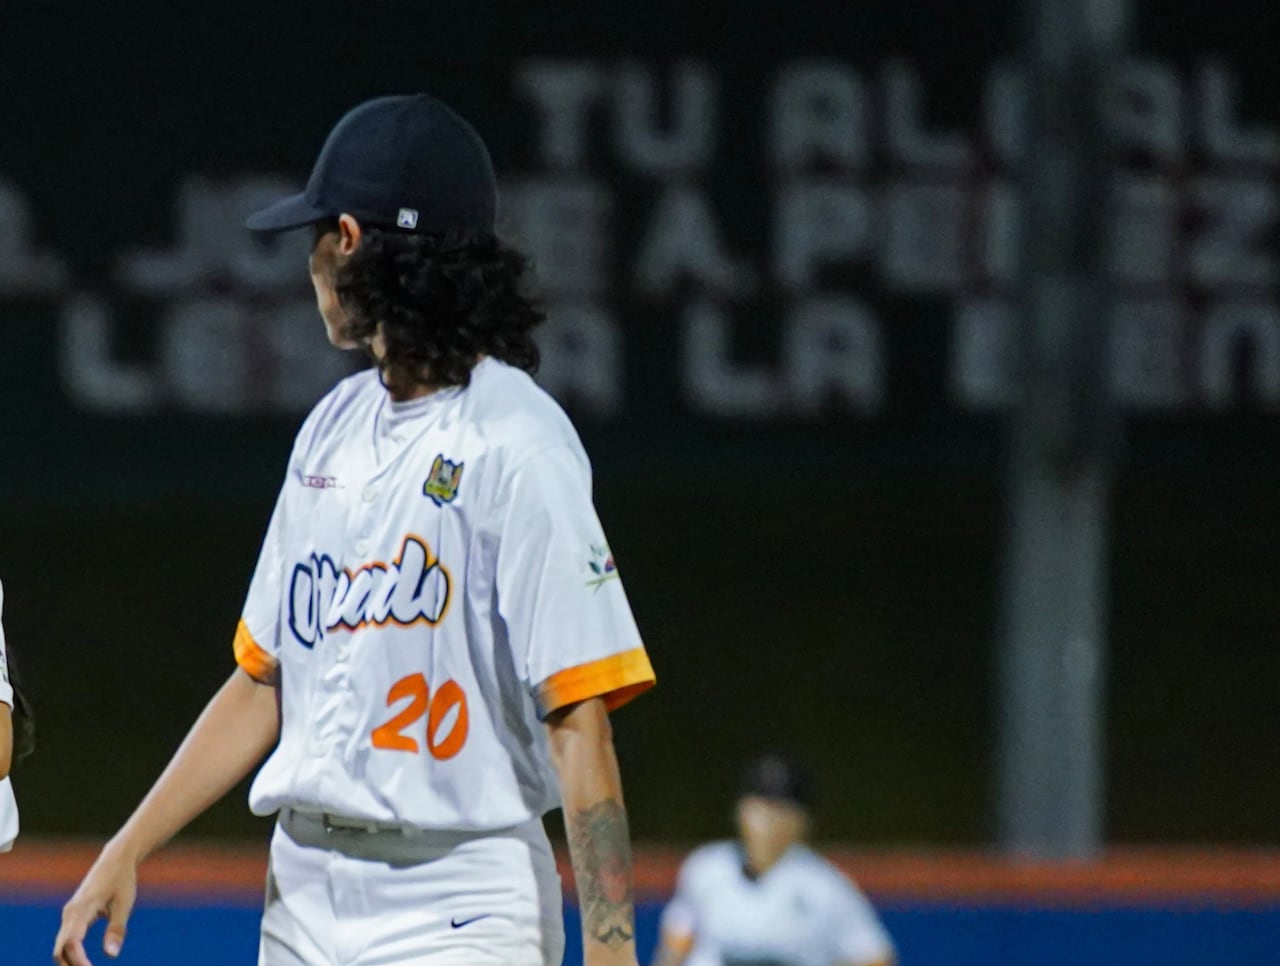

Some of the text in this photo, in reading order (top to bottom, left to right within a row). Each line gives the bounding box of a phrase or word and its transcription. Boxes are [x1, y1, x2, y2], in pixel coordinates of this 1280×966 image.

[518, 58, 720, 170] TU
[118, 176, 613, 294] JOE
[684, 300, 884, 410] LA
[371, 671, 470, 762] 20
